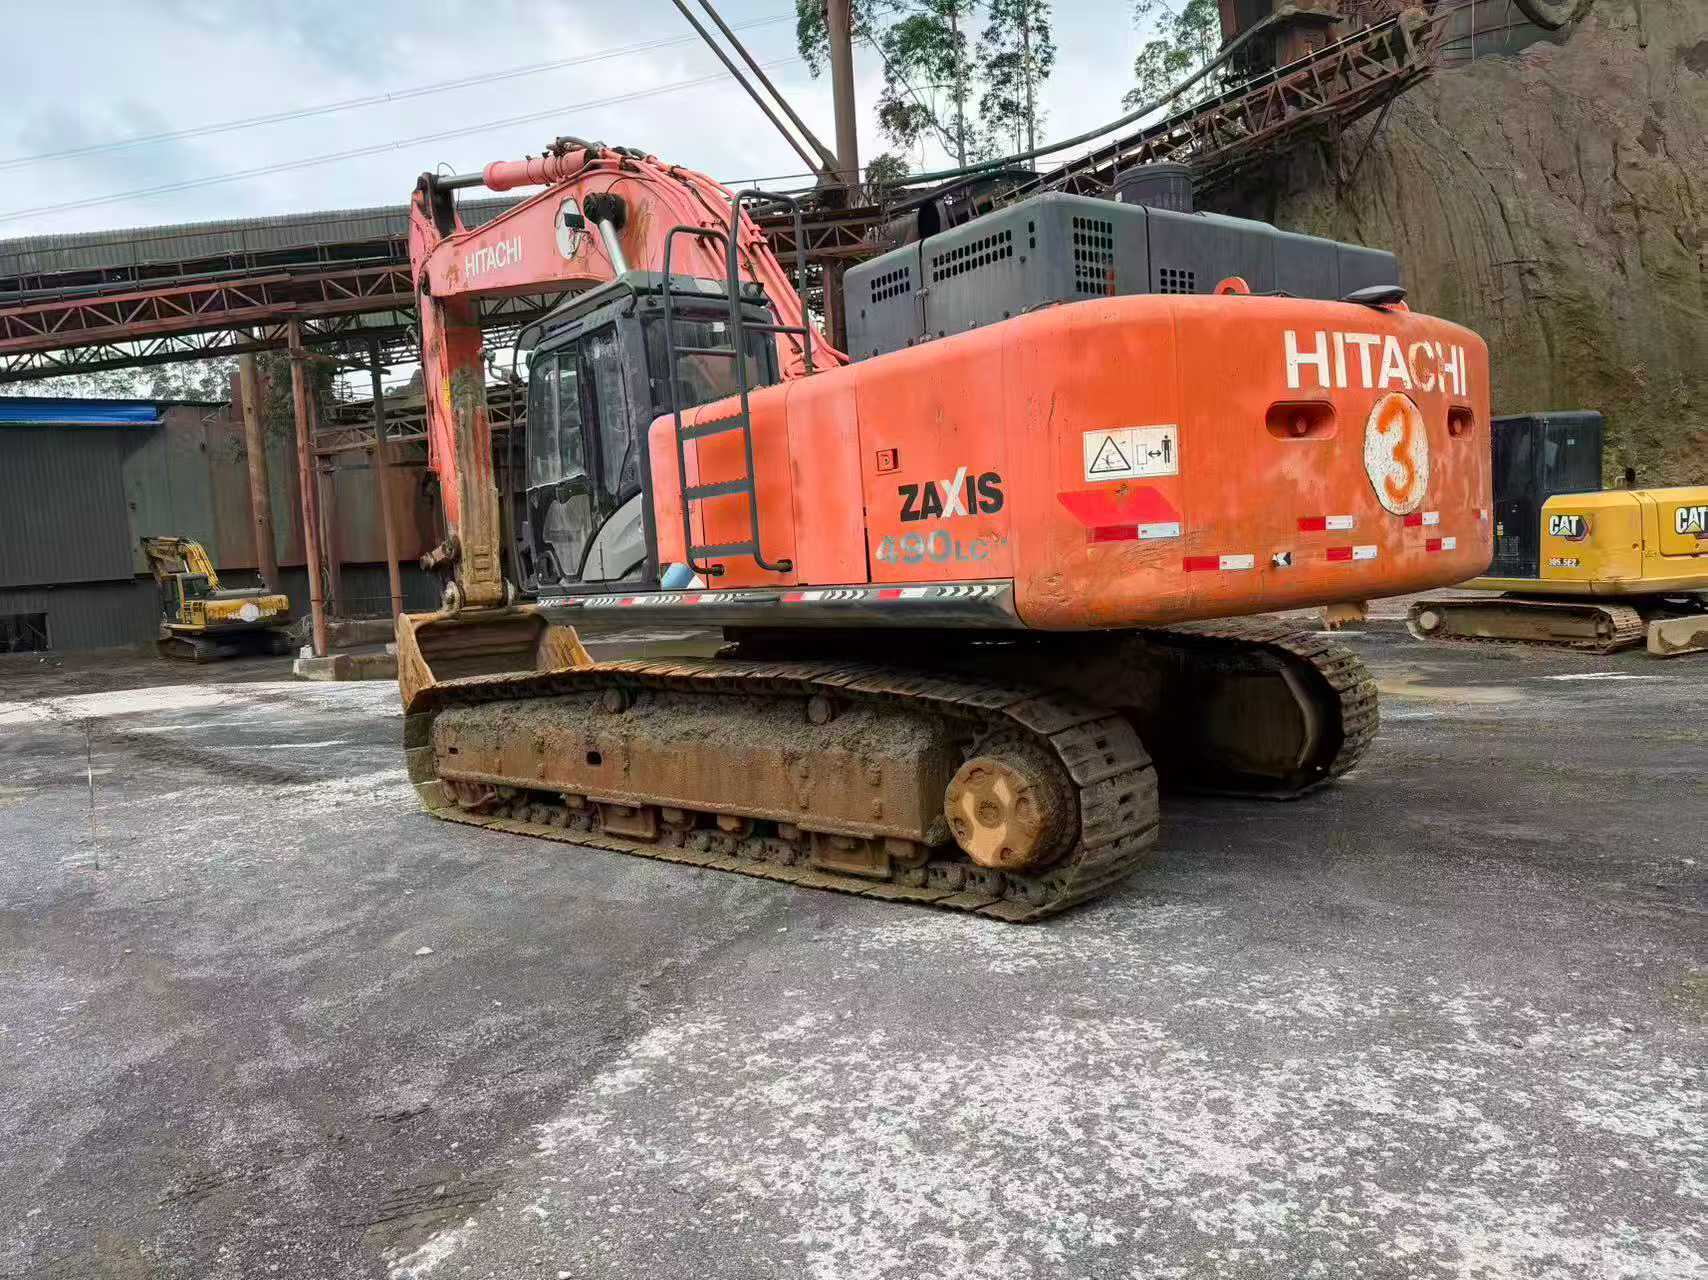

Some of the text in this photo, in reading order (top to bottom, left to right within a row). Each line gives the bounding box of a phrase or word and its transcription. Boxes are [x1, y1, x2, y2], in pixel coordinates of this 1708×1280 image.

[465, 235, 522, 277] HITACHI
[1284, 330, 1466, 396] HITACHI
[1378, 400, 1416, 501] 3
[898, 466, 1004, 522] ZAXIS
[1550, 515, 1579, 535] CAT
[1676, 507, 1706, 533] CAT
